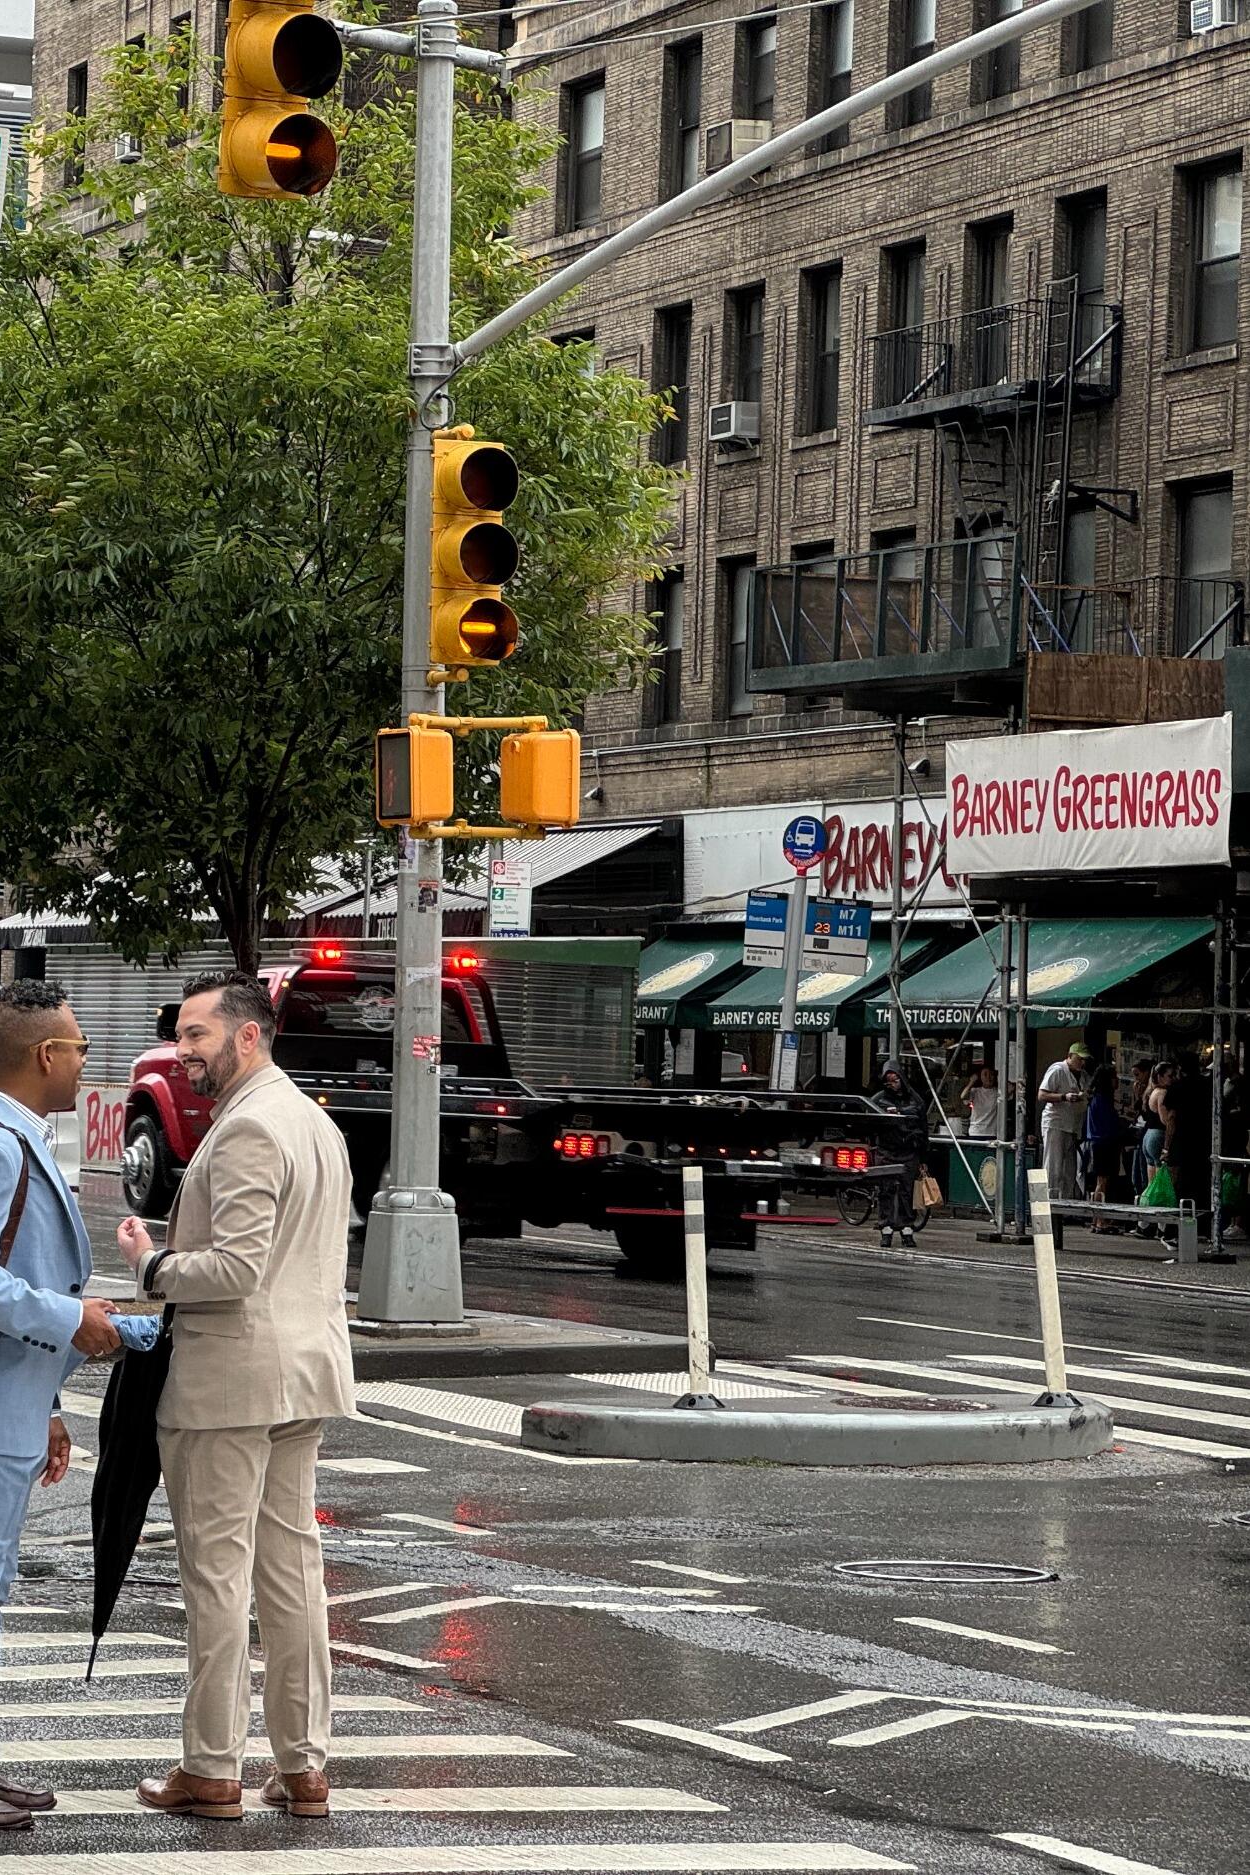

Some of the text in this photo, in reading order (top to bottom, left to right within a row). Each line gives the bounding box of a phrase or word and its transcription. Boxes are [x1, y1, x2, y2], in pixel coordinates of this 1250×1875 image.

[952, 765, 1222, 840] BARNEY GREENGRASS
[824, 815, 938, 892] BARNEY
[494, 888, 501, 900] 2
[839, 909, 857, 920] M7
[814, 922, 830, 934] 23
[837, 924, 862, 937] M11
[713, 1011, 830, 1026] BARNEY GREGRASS
[905, 1009, 971, 1023] STURGEON
[86, 1090, 124, 1161] BAR
